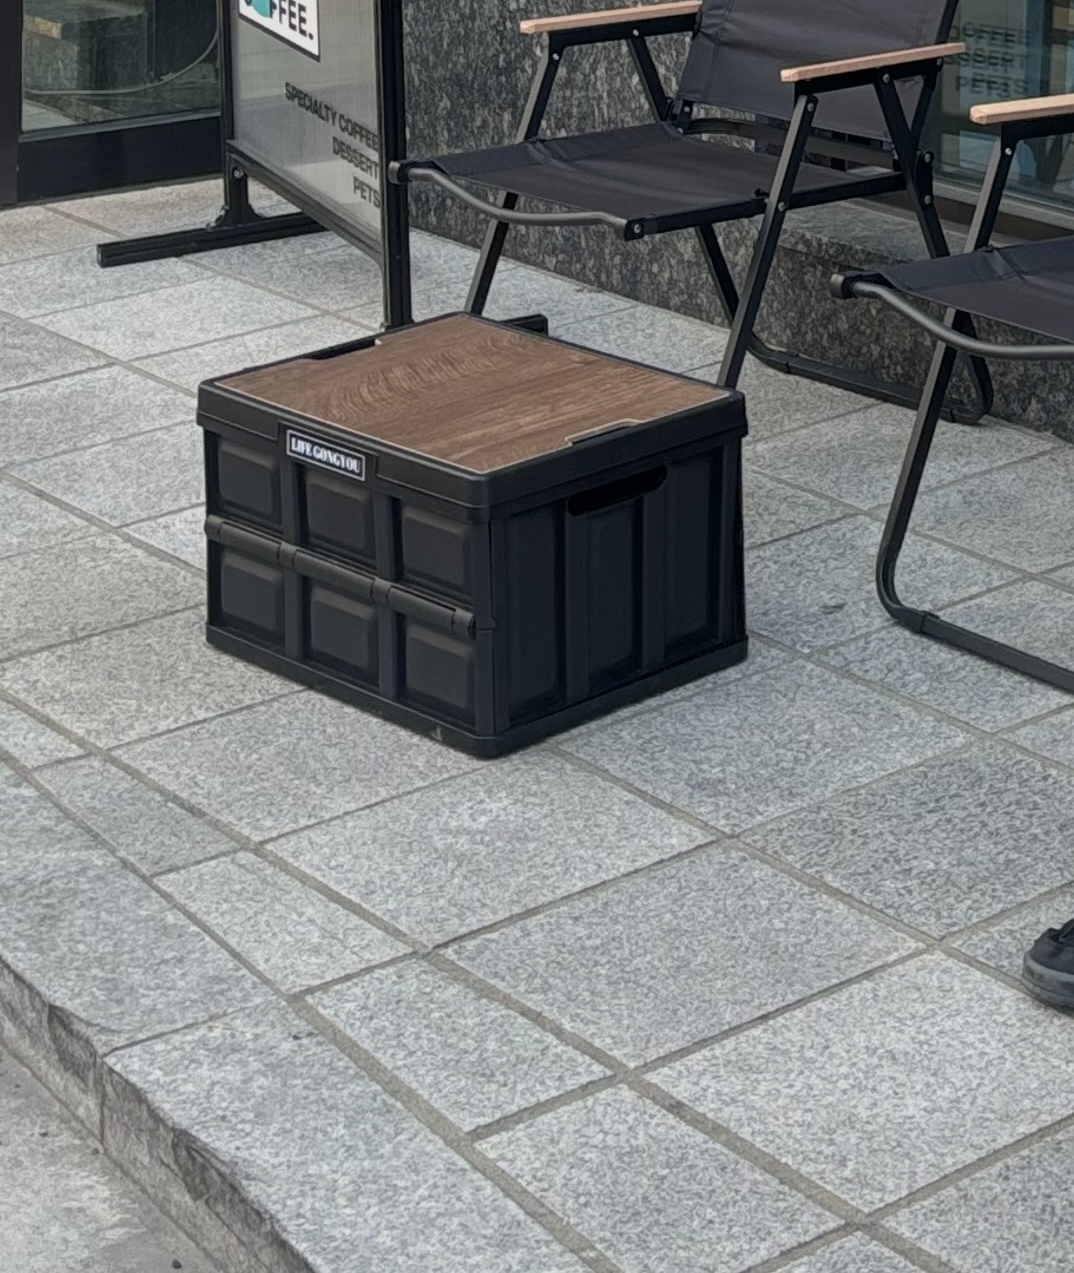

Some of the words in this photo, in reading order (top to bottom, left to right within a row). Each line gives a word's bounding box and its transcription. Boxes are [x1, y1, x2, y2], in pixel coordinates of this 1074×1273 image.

[285, 82, 337, 126] SPECIALTY
[339, 113, 379, 154] COFFEE
[332, 136, 379, 180] DESSERT
[353, 176, 380, 209] PETS
[291, 437, 312, 457] LIFE
[313, 446, 360, 474] GONGYOU
